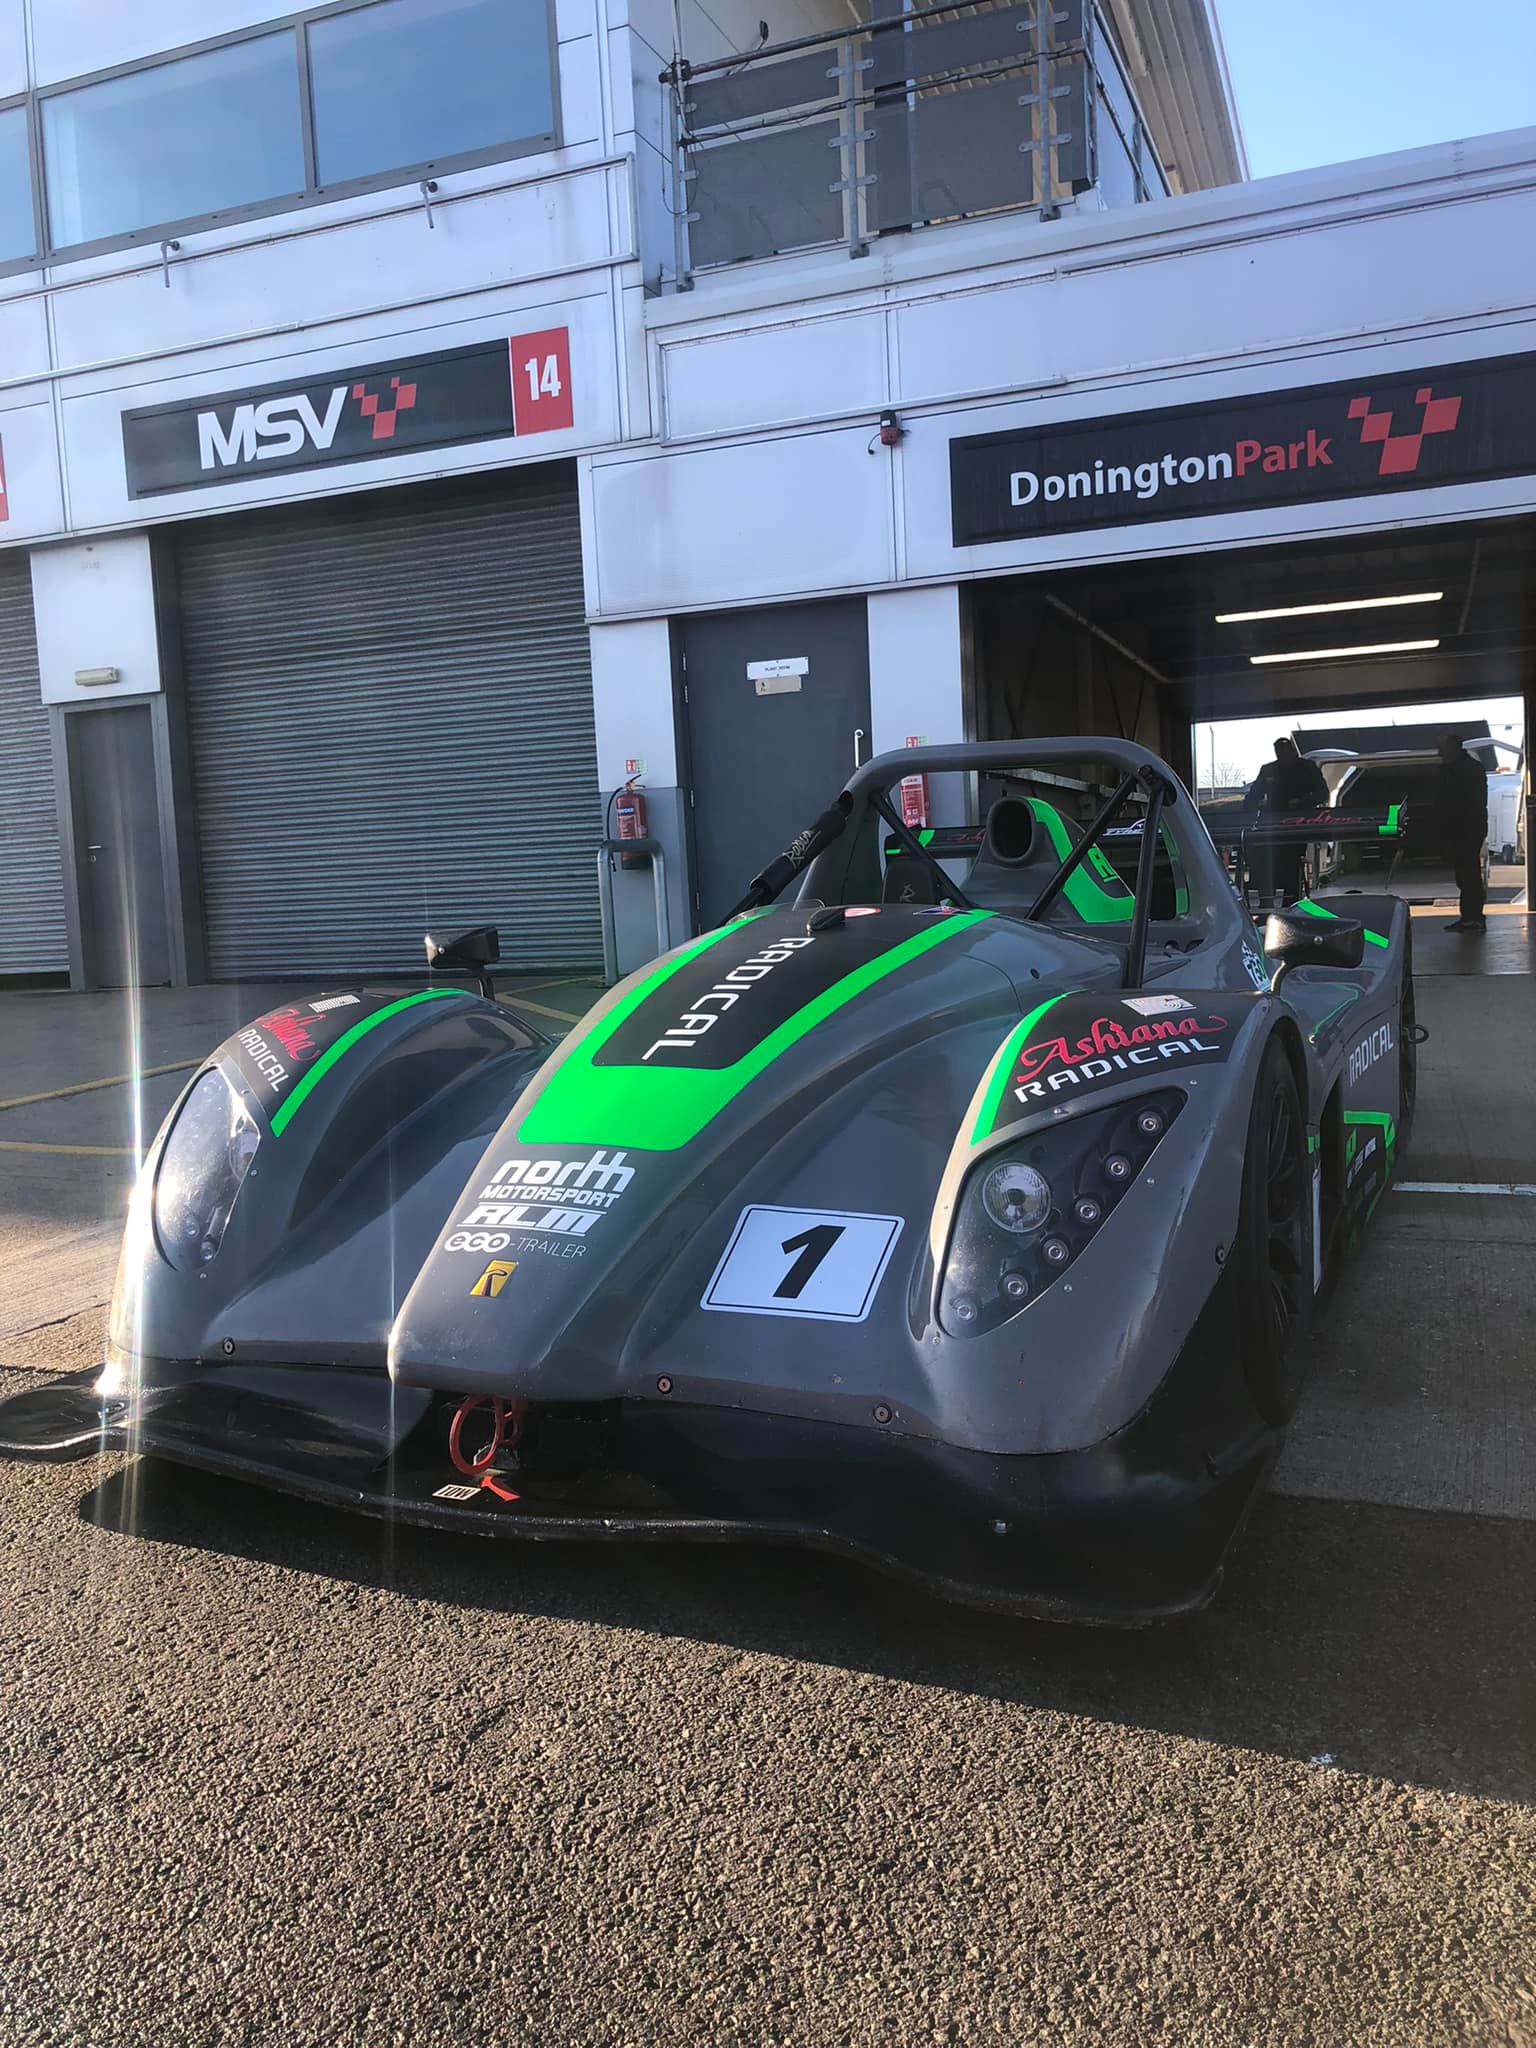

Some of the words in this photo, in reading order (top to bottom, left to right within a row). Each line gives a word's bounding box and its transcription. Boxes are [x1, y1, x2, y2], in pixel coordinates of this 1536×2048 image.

[523, 353, 562, 401] 14
[196, 386, 348, 470] MSV
[641, 936, 817, 1061] RADICAL
[238, 1028, 289, 1092] RADICAL
[1013, 1037, 1220, 1104] RADICAL
[1016, 1015, 1228, 1083] Ashiana
[1349, 1022, 1394, 1087] RADICAL
[478, 1184, 621, 1209] MOTORSPORT
[490, 1150, 636, 1193] north
[780, 1223, 847, 1299] 1
